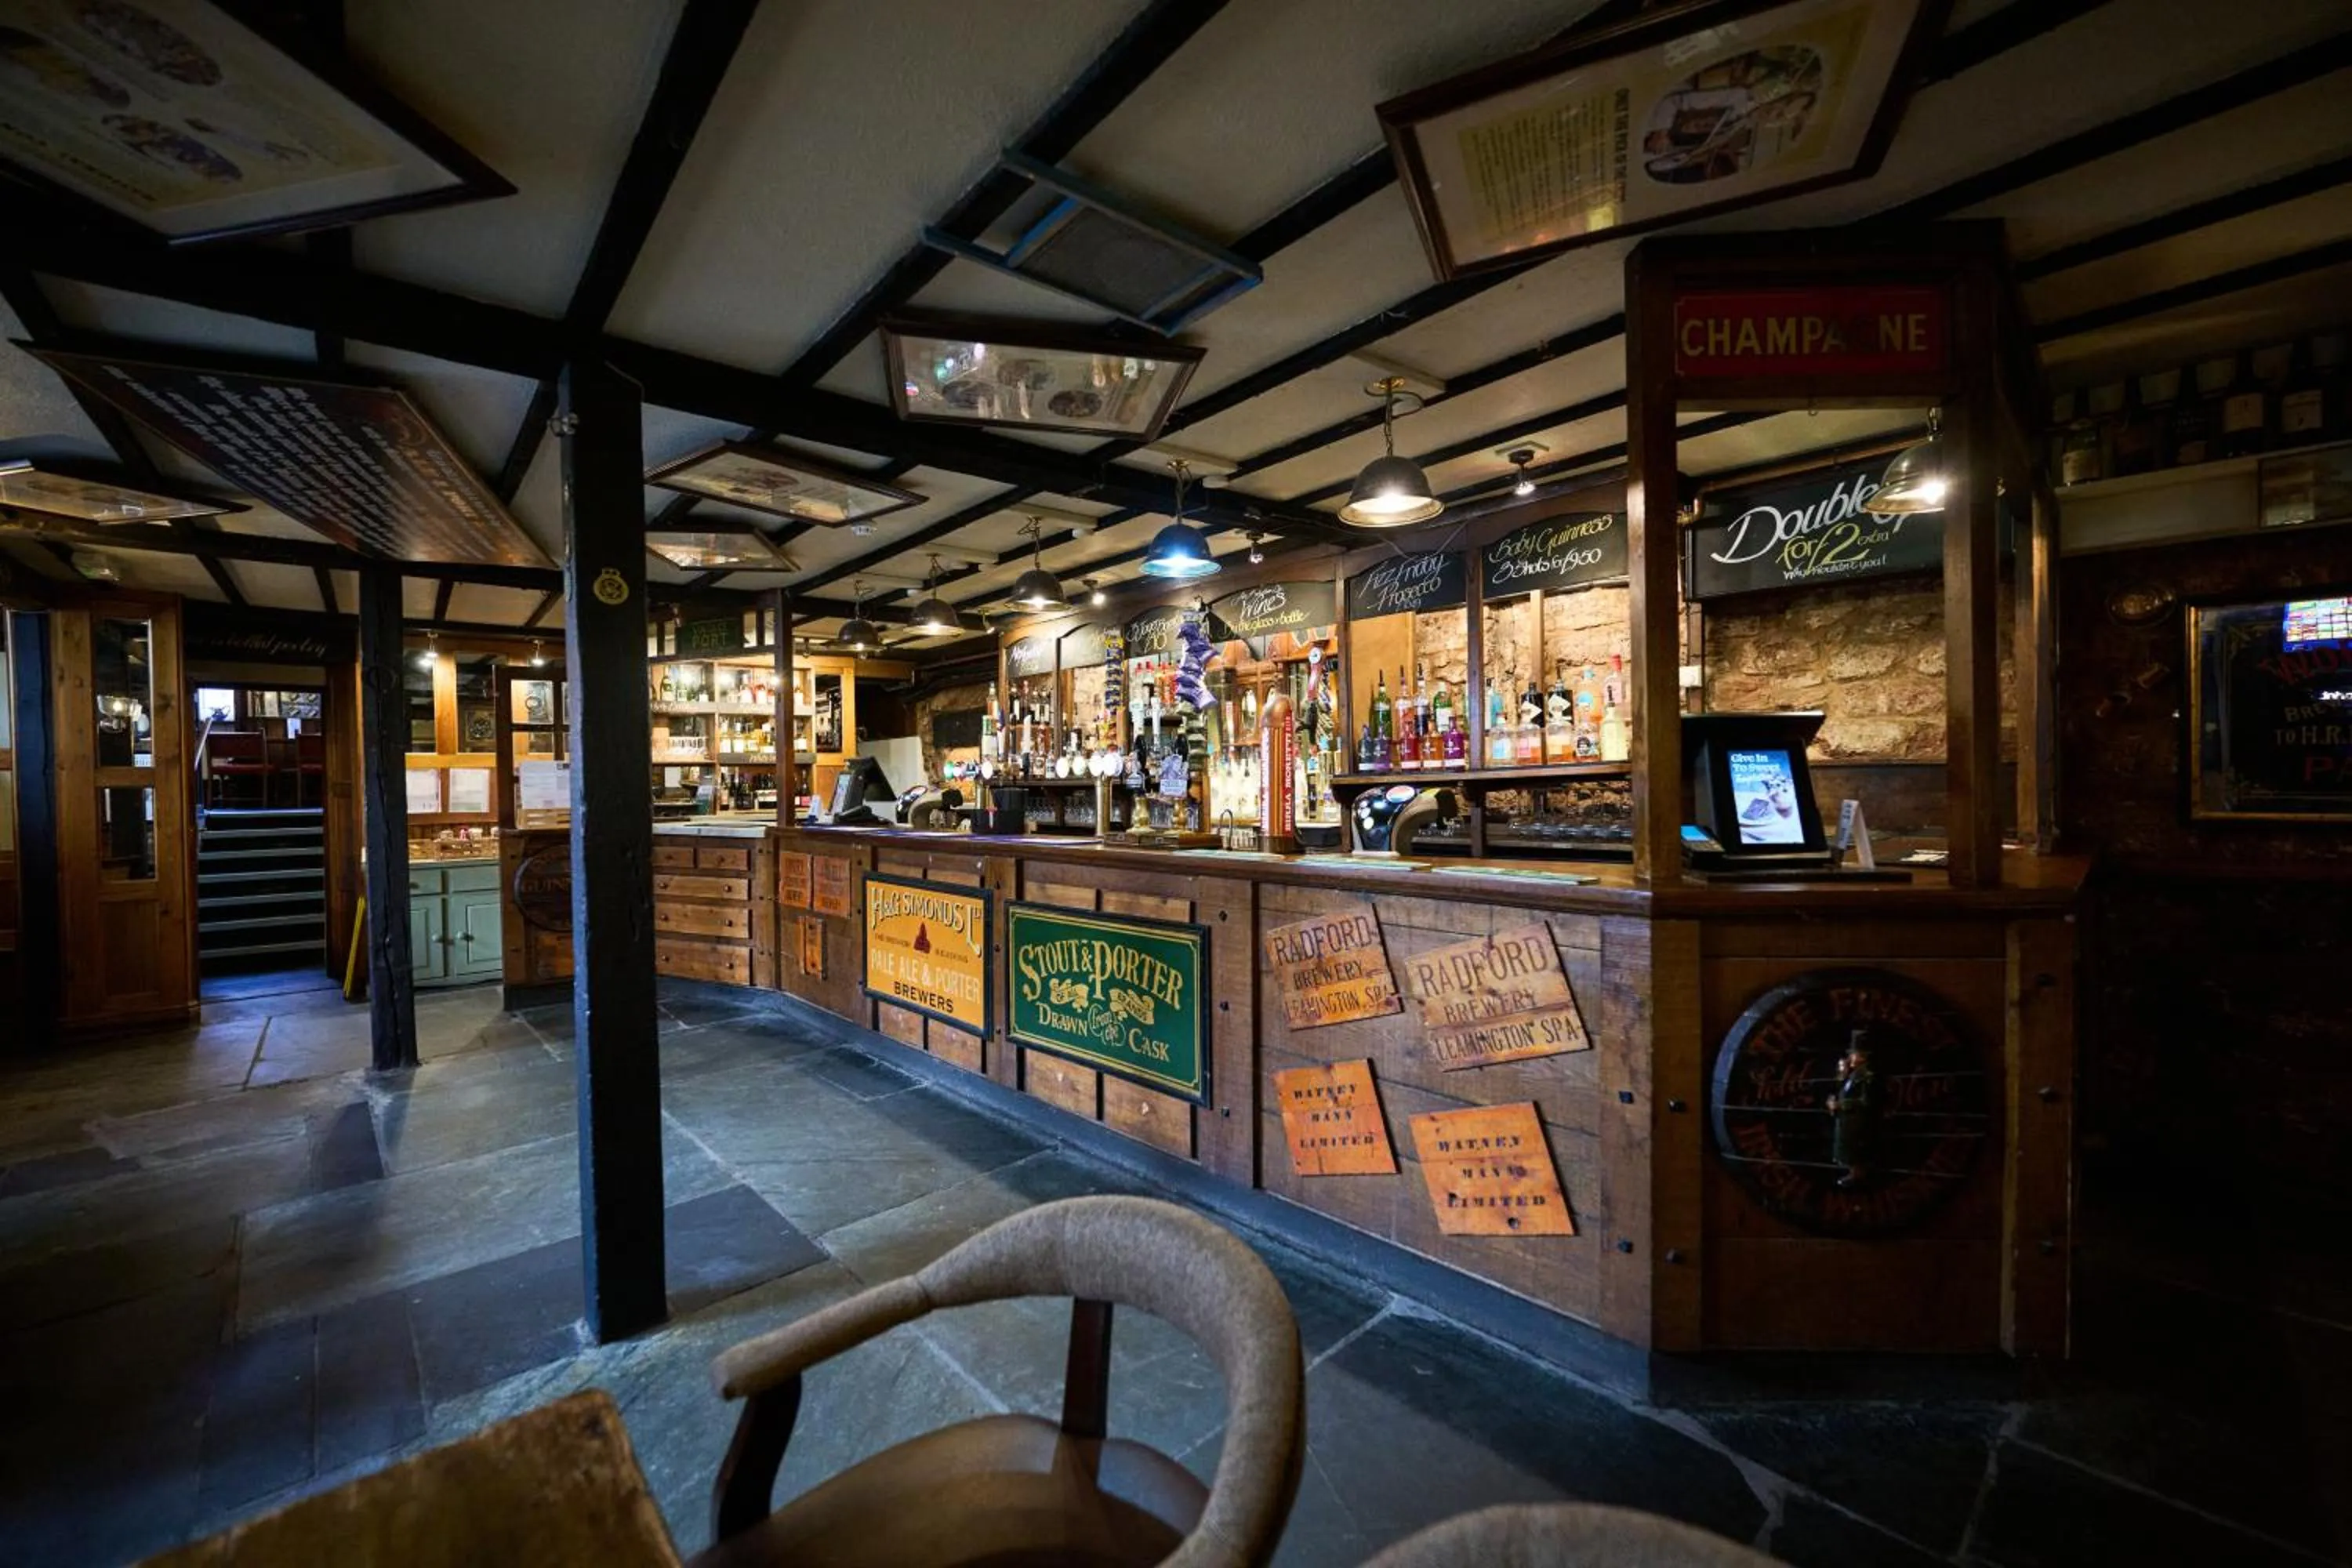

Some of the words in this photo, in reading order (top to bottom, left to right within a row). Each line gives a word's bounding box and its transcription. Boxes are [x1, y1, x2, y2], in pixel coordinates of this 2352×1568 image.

[1681, 313, 1929, 357] CHAMPANE
[1490, 528, 1535, 563] Baby
[1537, 514, 1613, 557] Guinness
[1711, 474, 1880, 564] Double
[1857, 530, 1889, 546] extra
[1240, 592, 1286, 622] Wines
[1730, 753, 1755, 763] Give
[1756, 753, 1769, 763] In
[903, 891, 965, 934] SIMONDS
[1273, 916, 1374, 967] RADFORD
[871, 948, 895, 976] PALE
[899, 955, 920, 982] ALE
[935, 966, 980, 1003] PORTER
[1018, 939, 1080, 1002] STOUT
[1081, 939, 1094, 973] &
[1089, 940, 1183, 1011] PORTER
[1293, 960, 1364, 991] BREWERY
[1418, 936, 1548, 998] RADFORD
[893, 981, 954, 1014] BREWERS
[1444, 989, 1537, 1025] BREWERY
[1036, 1001, 1088, 1037] DRAWN
[1129, 1028, 1171, 1062] CASK
[1435, 1022, 1534, 1062] LEAMINGTON
[1540, 1015, 1581, 1044] SPA
[1294, 1083, 1358, 1099] WATNEY
[1439, 1136, 1520, 1152] WATNEY
